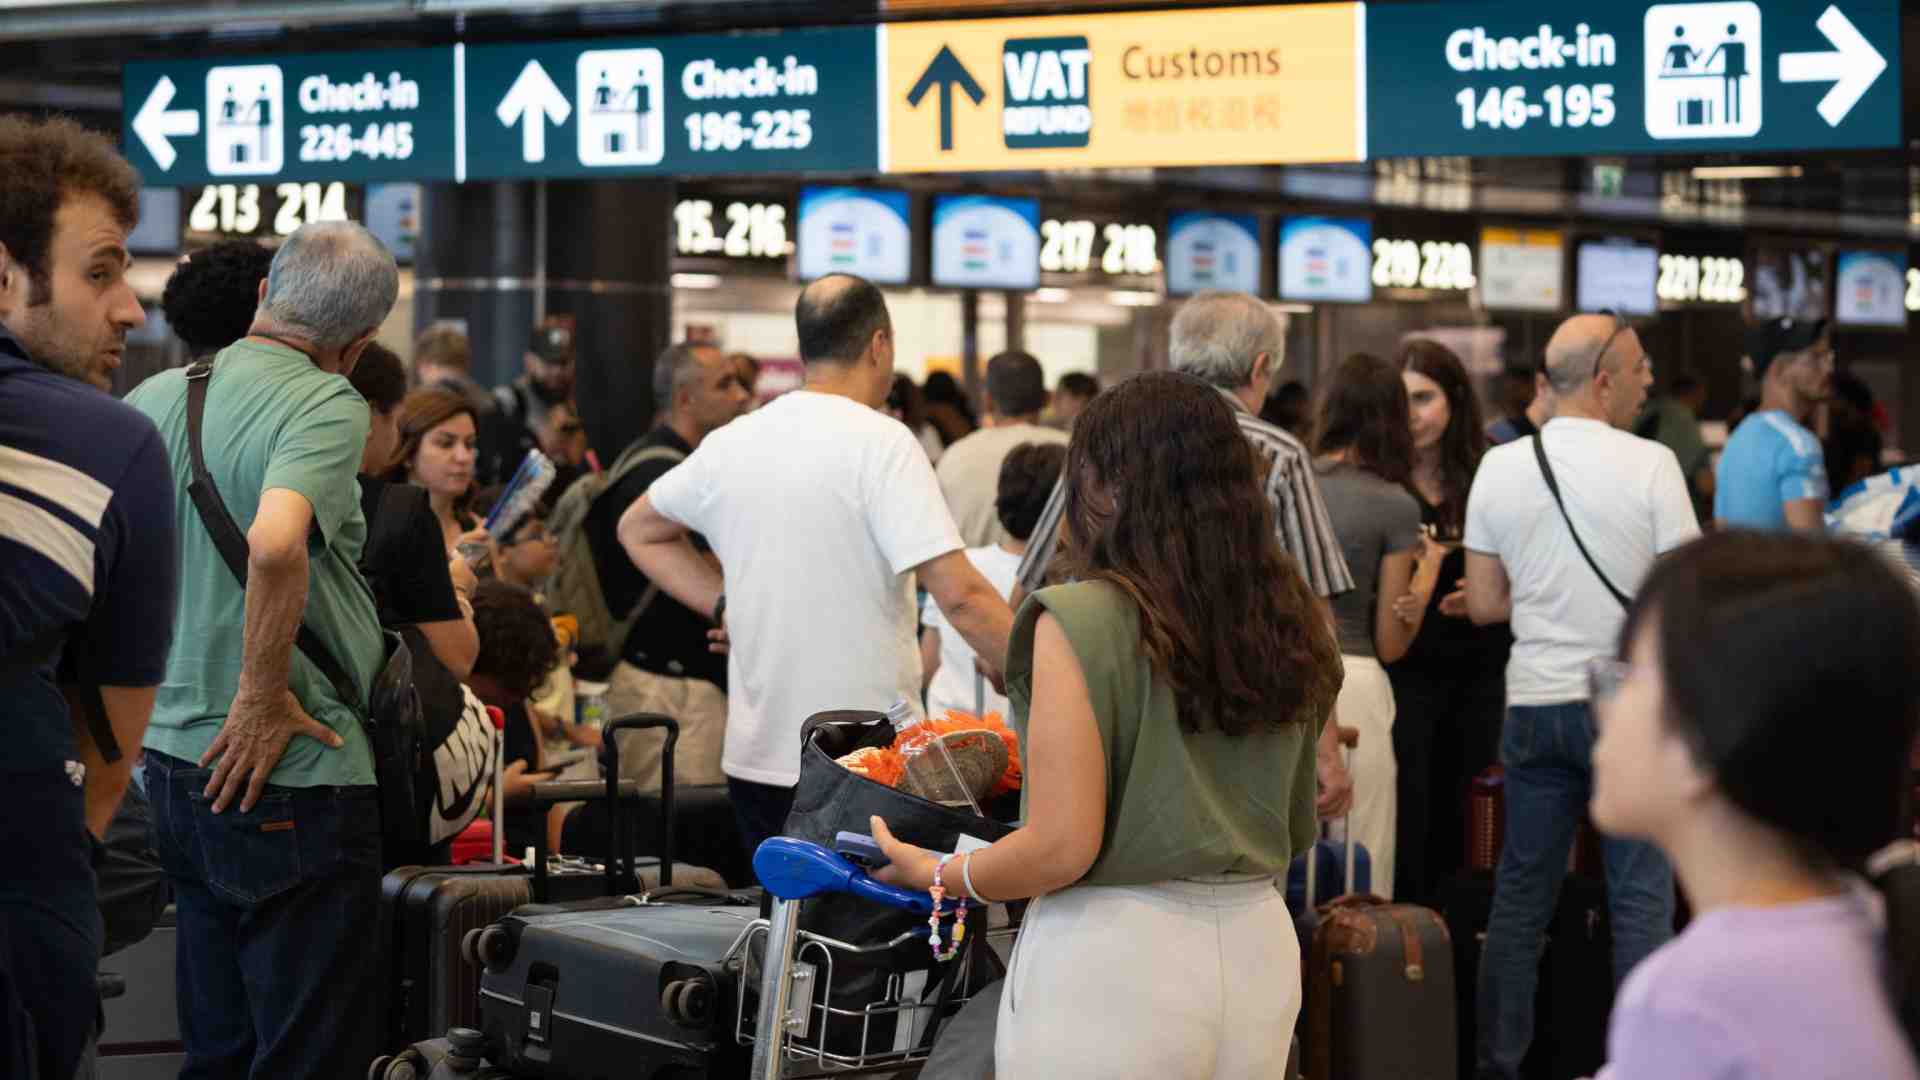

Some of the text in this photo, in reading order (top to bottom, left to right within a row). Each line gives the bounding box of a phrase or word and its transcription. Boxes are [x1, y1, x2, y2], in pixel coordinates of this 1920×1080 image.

[1122, 46, 1281, 80] Customs
[1446, 24, 1615, 71] Check-in
[299, 72, 419, 113] Check-in
[683, 56, 818, 98] Check-in
[1003, 49, 1090, 101] VAT
[1457, 84, 1616, 129] 146-195
[300, 122, 413, 161] 226-445
[686, 109, 812, 151] 196-225
[190, 184, 260, 232] 213
[274, 181, 348, 234] 214
[674, 200, 715, 253] 15
[724, 202, 787, 257] 216
[1040, 220, 1096, 271] 217
